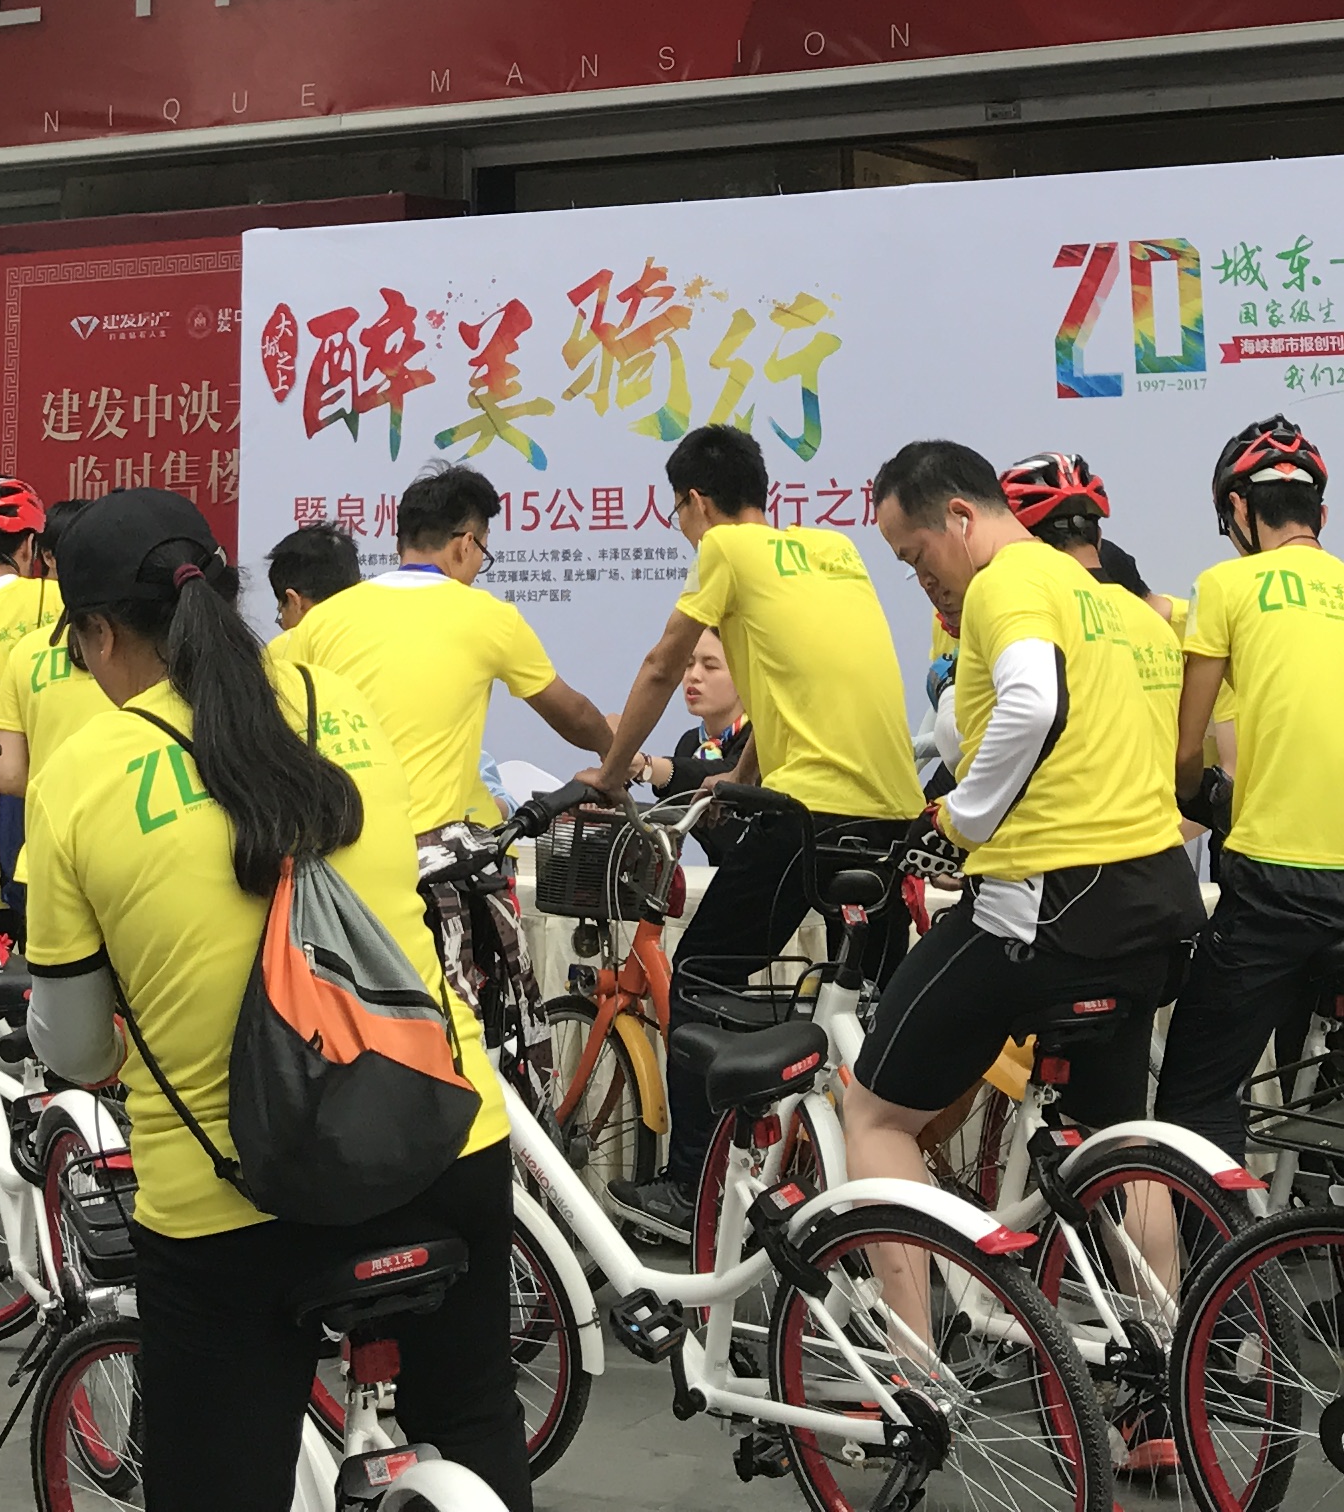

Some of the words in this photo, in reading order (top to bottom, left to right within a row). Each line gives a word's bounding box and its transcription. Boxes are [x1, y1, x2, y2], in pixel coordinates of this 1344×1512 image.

[429, 22, 912, 95] MANSION
[262, 312, 294, 392] 大城之上
[302, 256, 843, 471] 醉美骑行
[1136, 378, 1207, 393] 1997-2017
[504, 589, 571, 603] 福兴妇产医院
[520, 1148, 574, 1222] Hellobike
